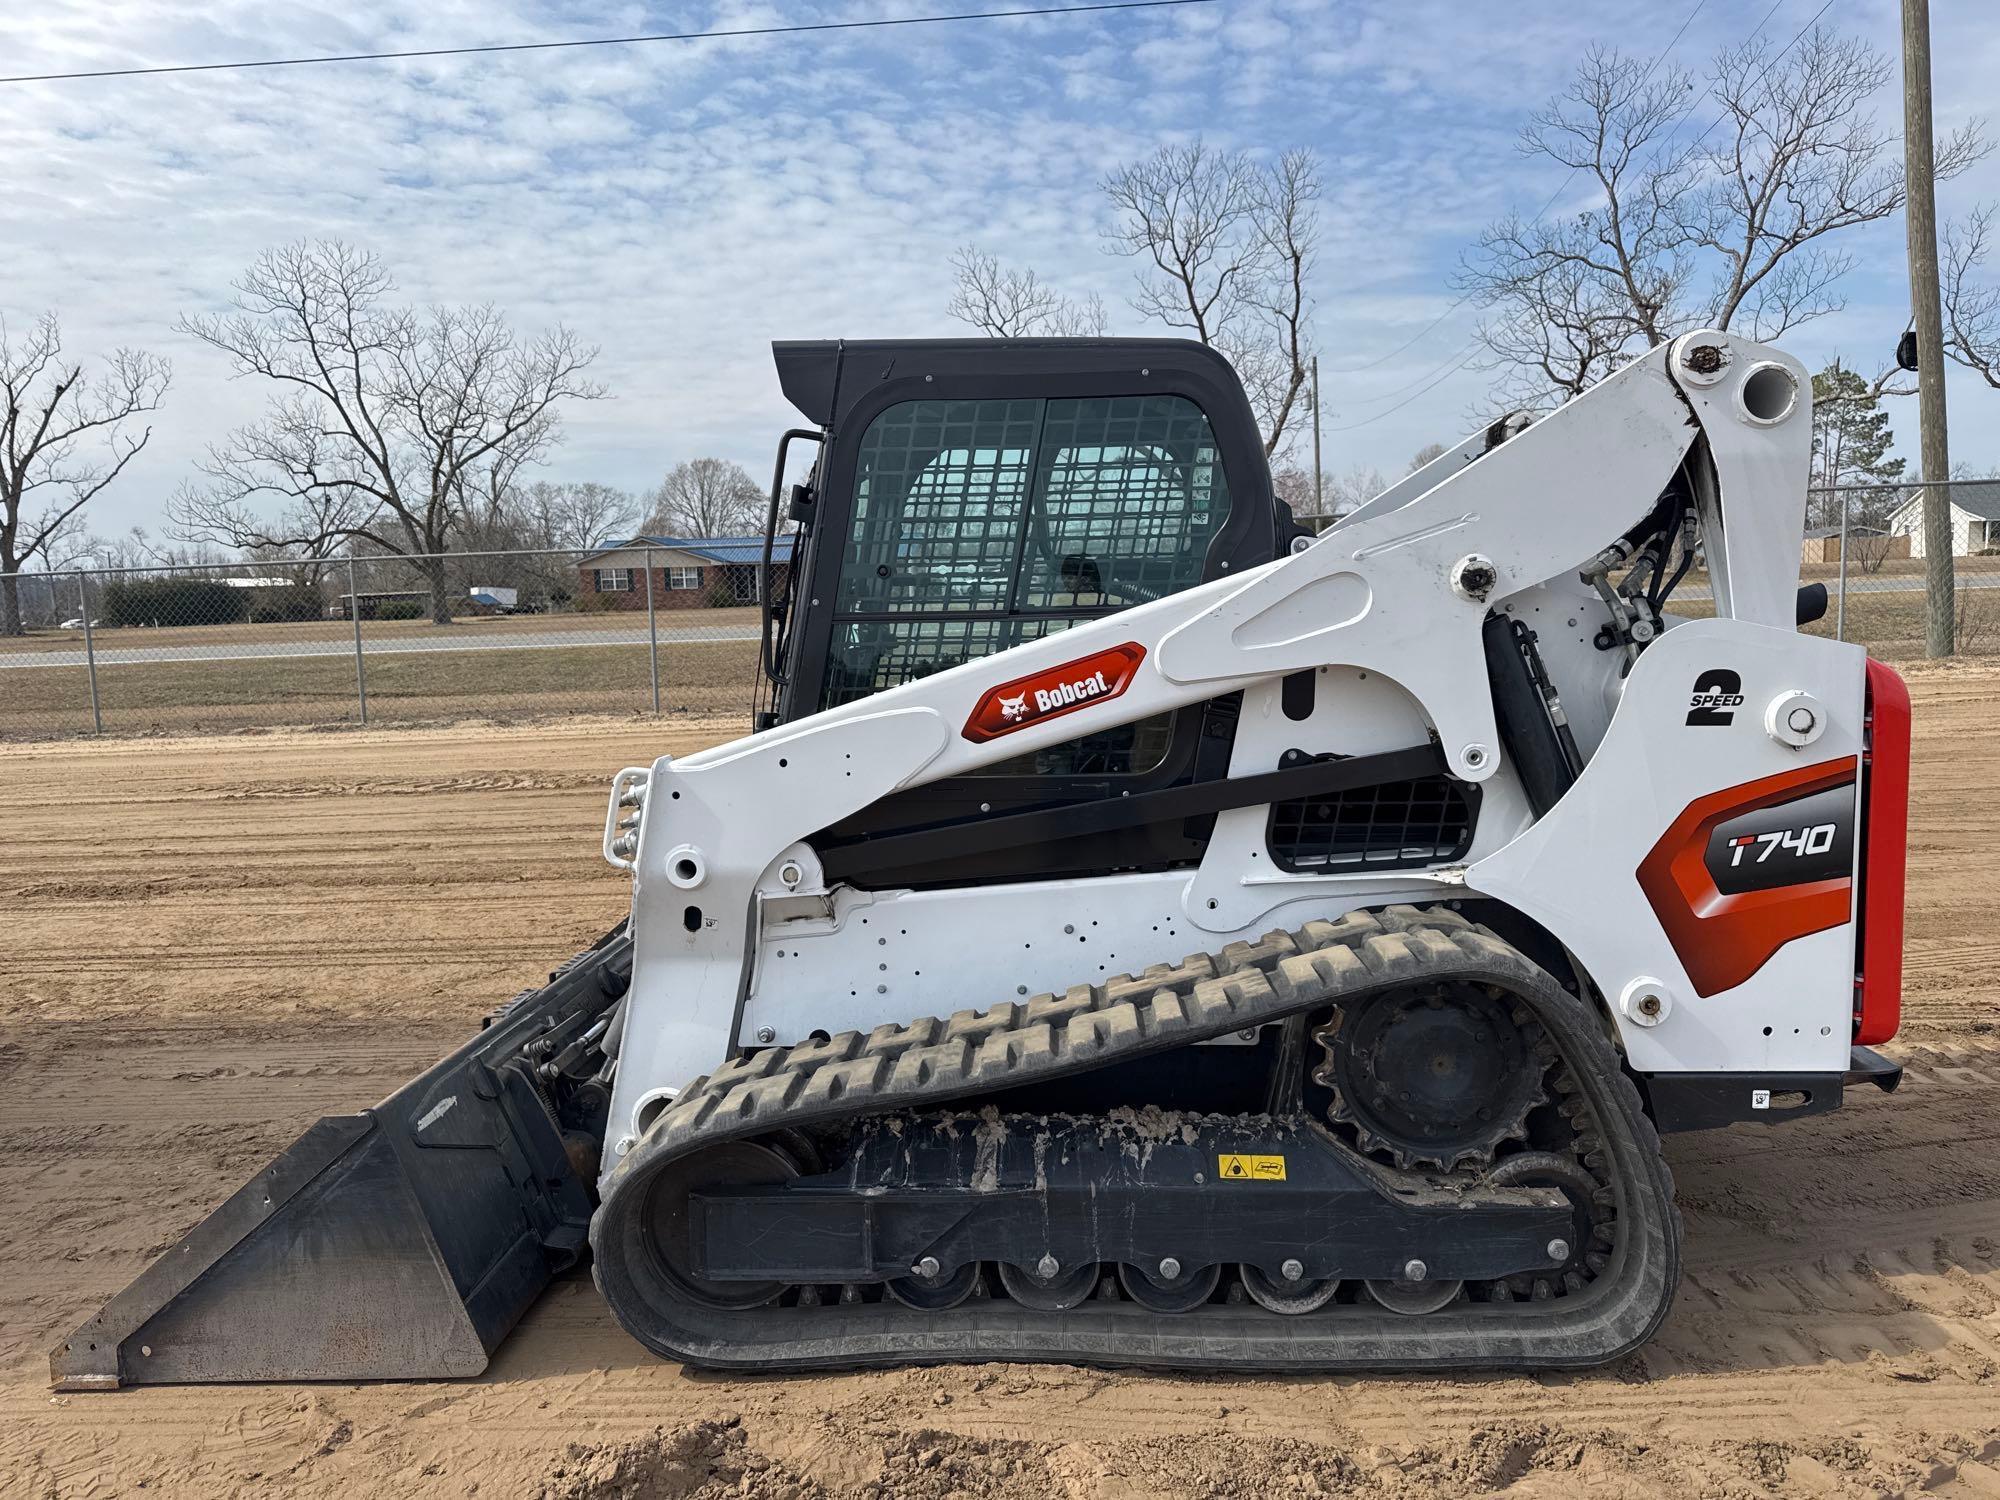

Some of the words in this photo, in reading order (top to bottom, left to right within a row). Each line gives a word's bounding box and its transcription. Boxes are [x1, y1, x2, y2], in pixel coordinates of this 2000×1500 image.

[1034, 671, 1107, 712] Bobcat
[1685, 669, 1741, 726] 2
[1690, 695, 1744, 706] SPEED
[1728, 823, 1837, 867] T740
